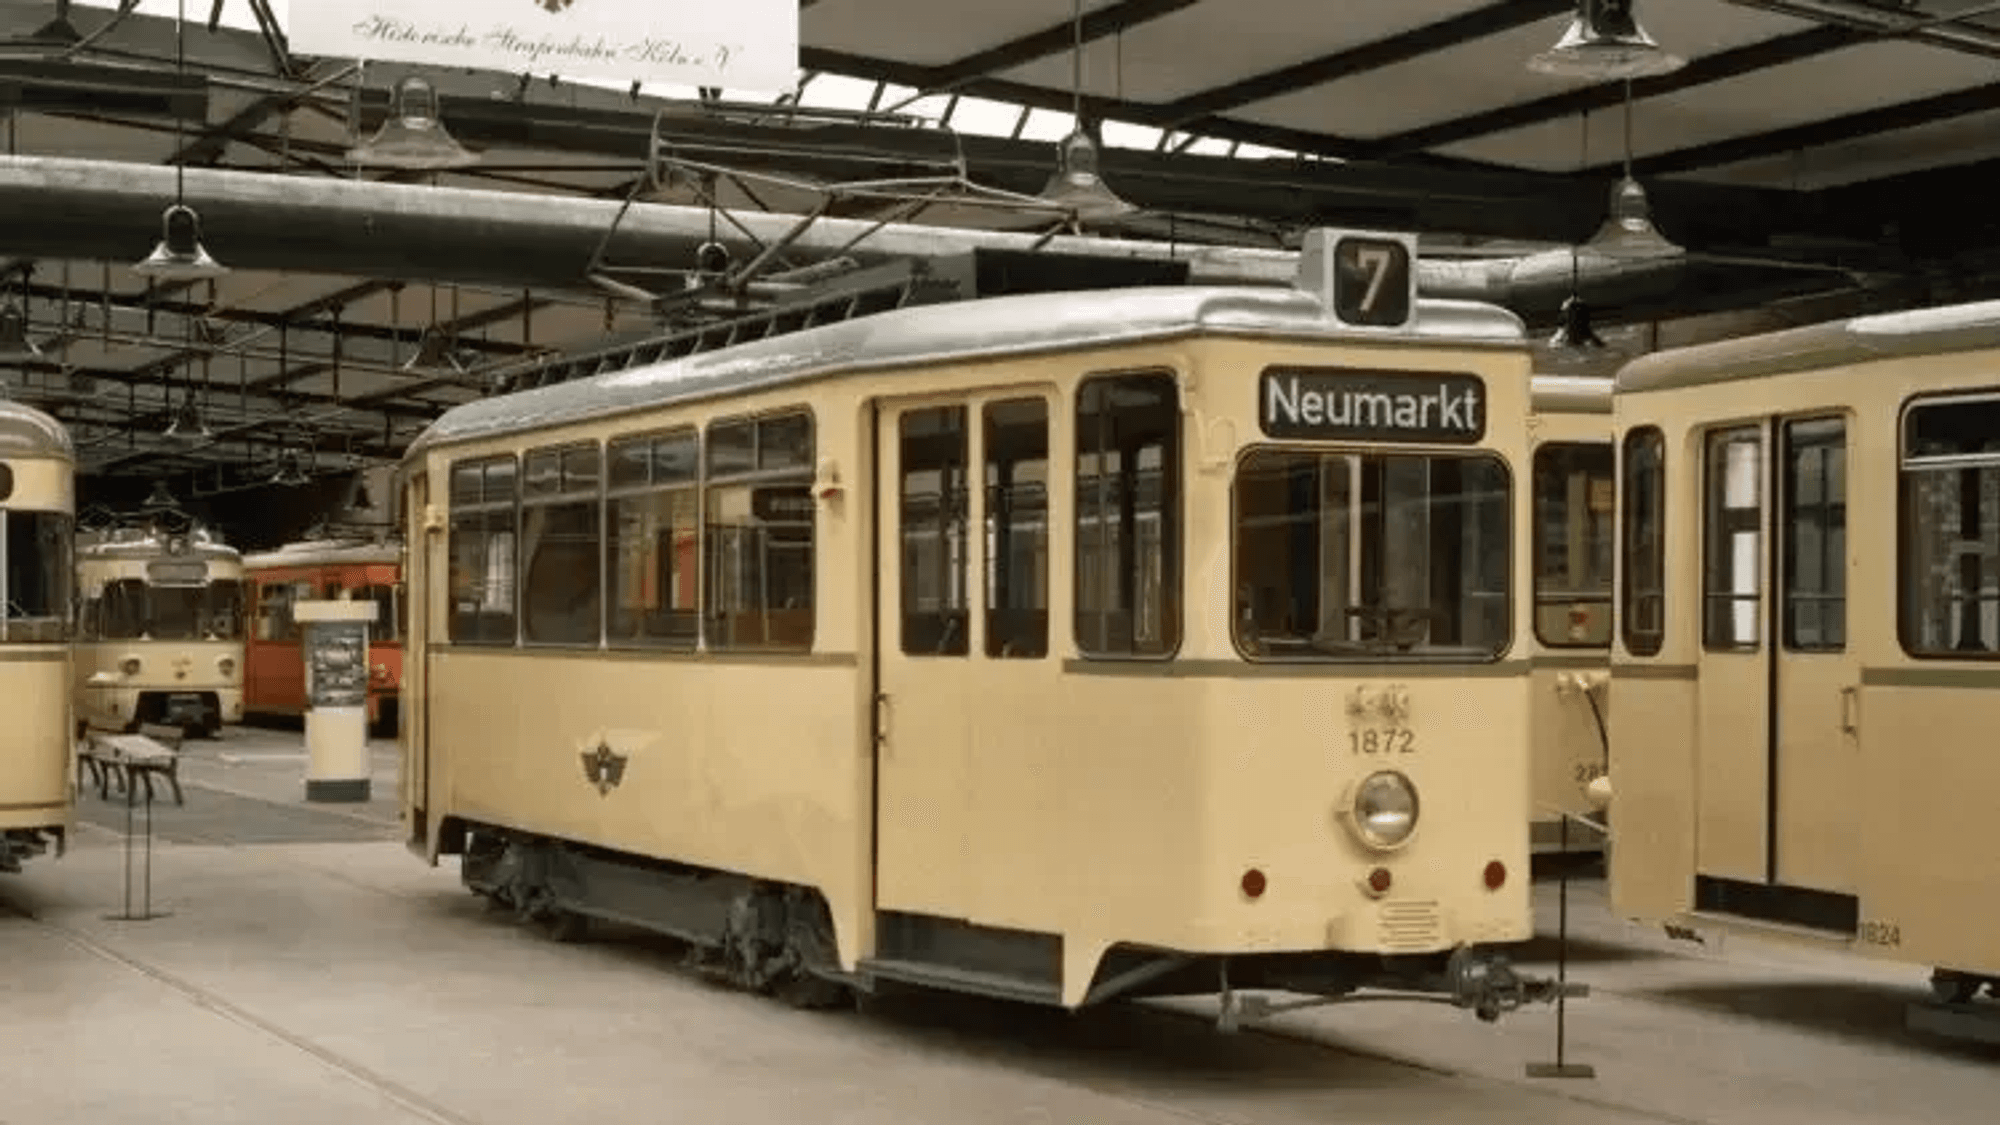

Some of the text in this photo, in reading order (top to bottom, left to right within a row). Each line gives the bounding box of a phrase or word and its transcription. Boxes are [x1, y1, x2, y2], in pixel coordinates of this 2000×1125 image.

[1355, 246, 1392, 313] 7
[1267, 375, 1481, 431] Neumarkt
[1347, 727, 1416, 756] 1872
